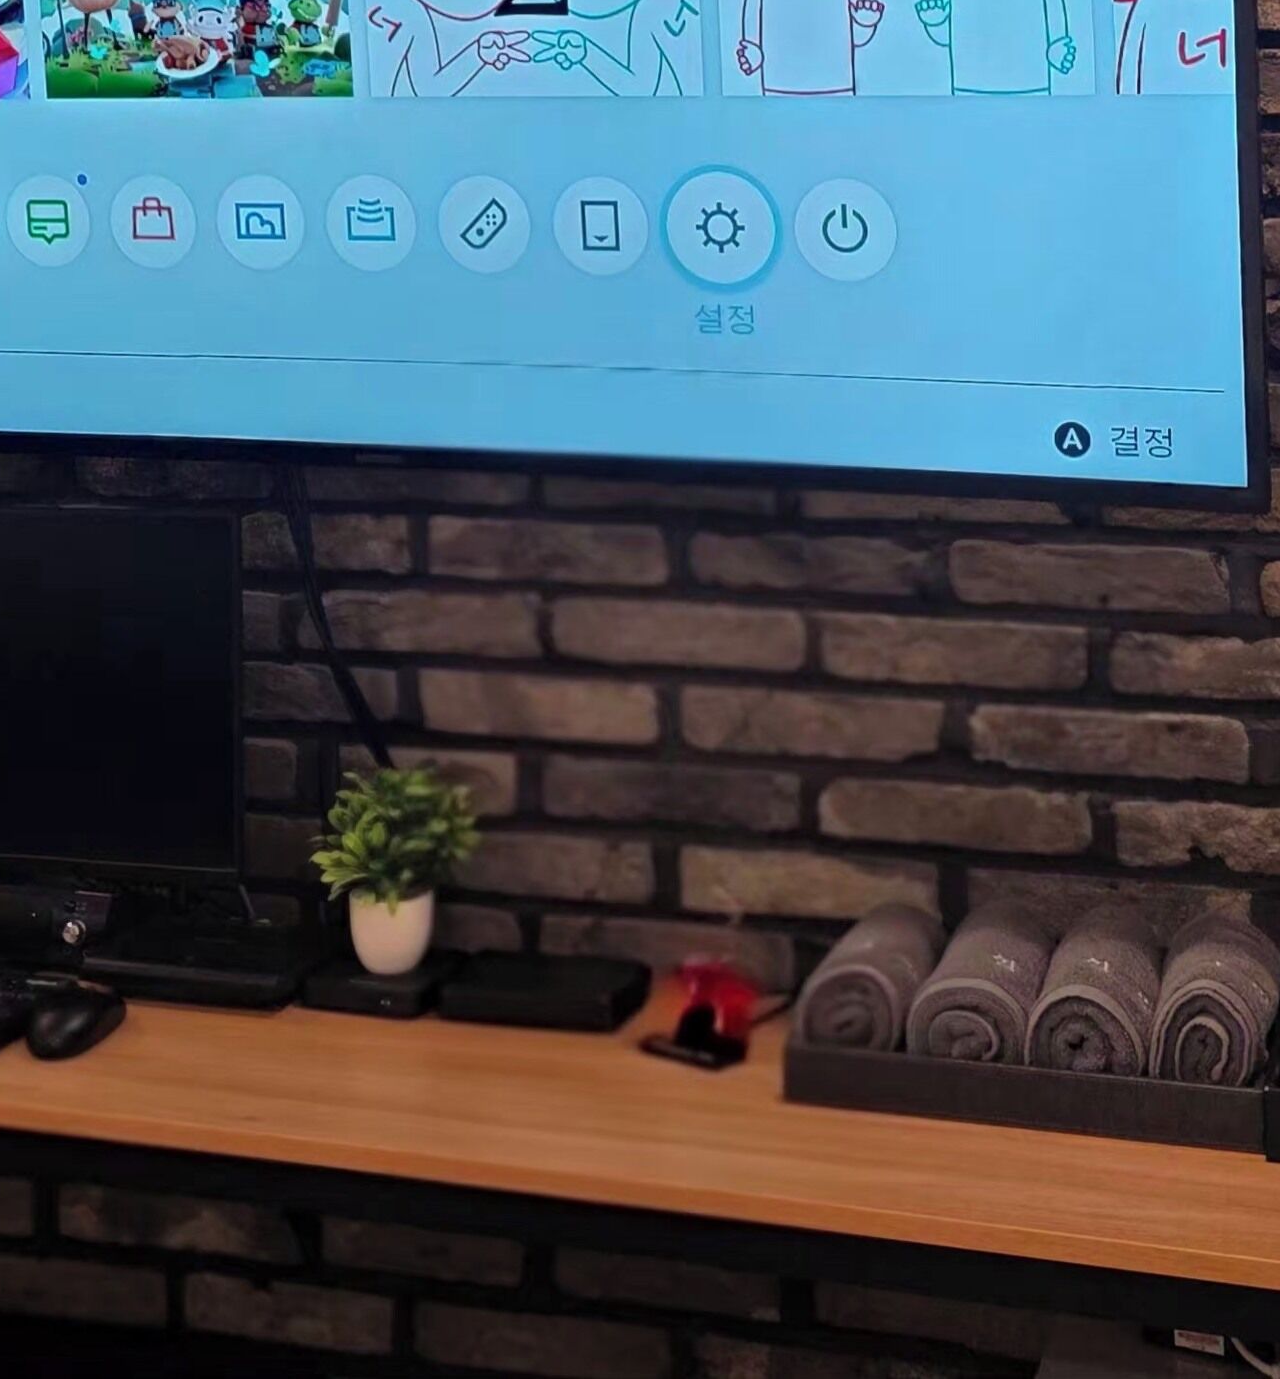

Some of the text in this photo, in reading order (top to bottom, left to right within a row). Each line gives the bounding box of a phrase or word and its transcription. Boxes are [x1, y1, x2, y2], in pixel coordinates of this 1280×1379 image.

[1178, 27, 1227, 69] 너
[694, 303, 754, 335] 설정
[1111, 426, 1173, 458] 결정
